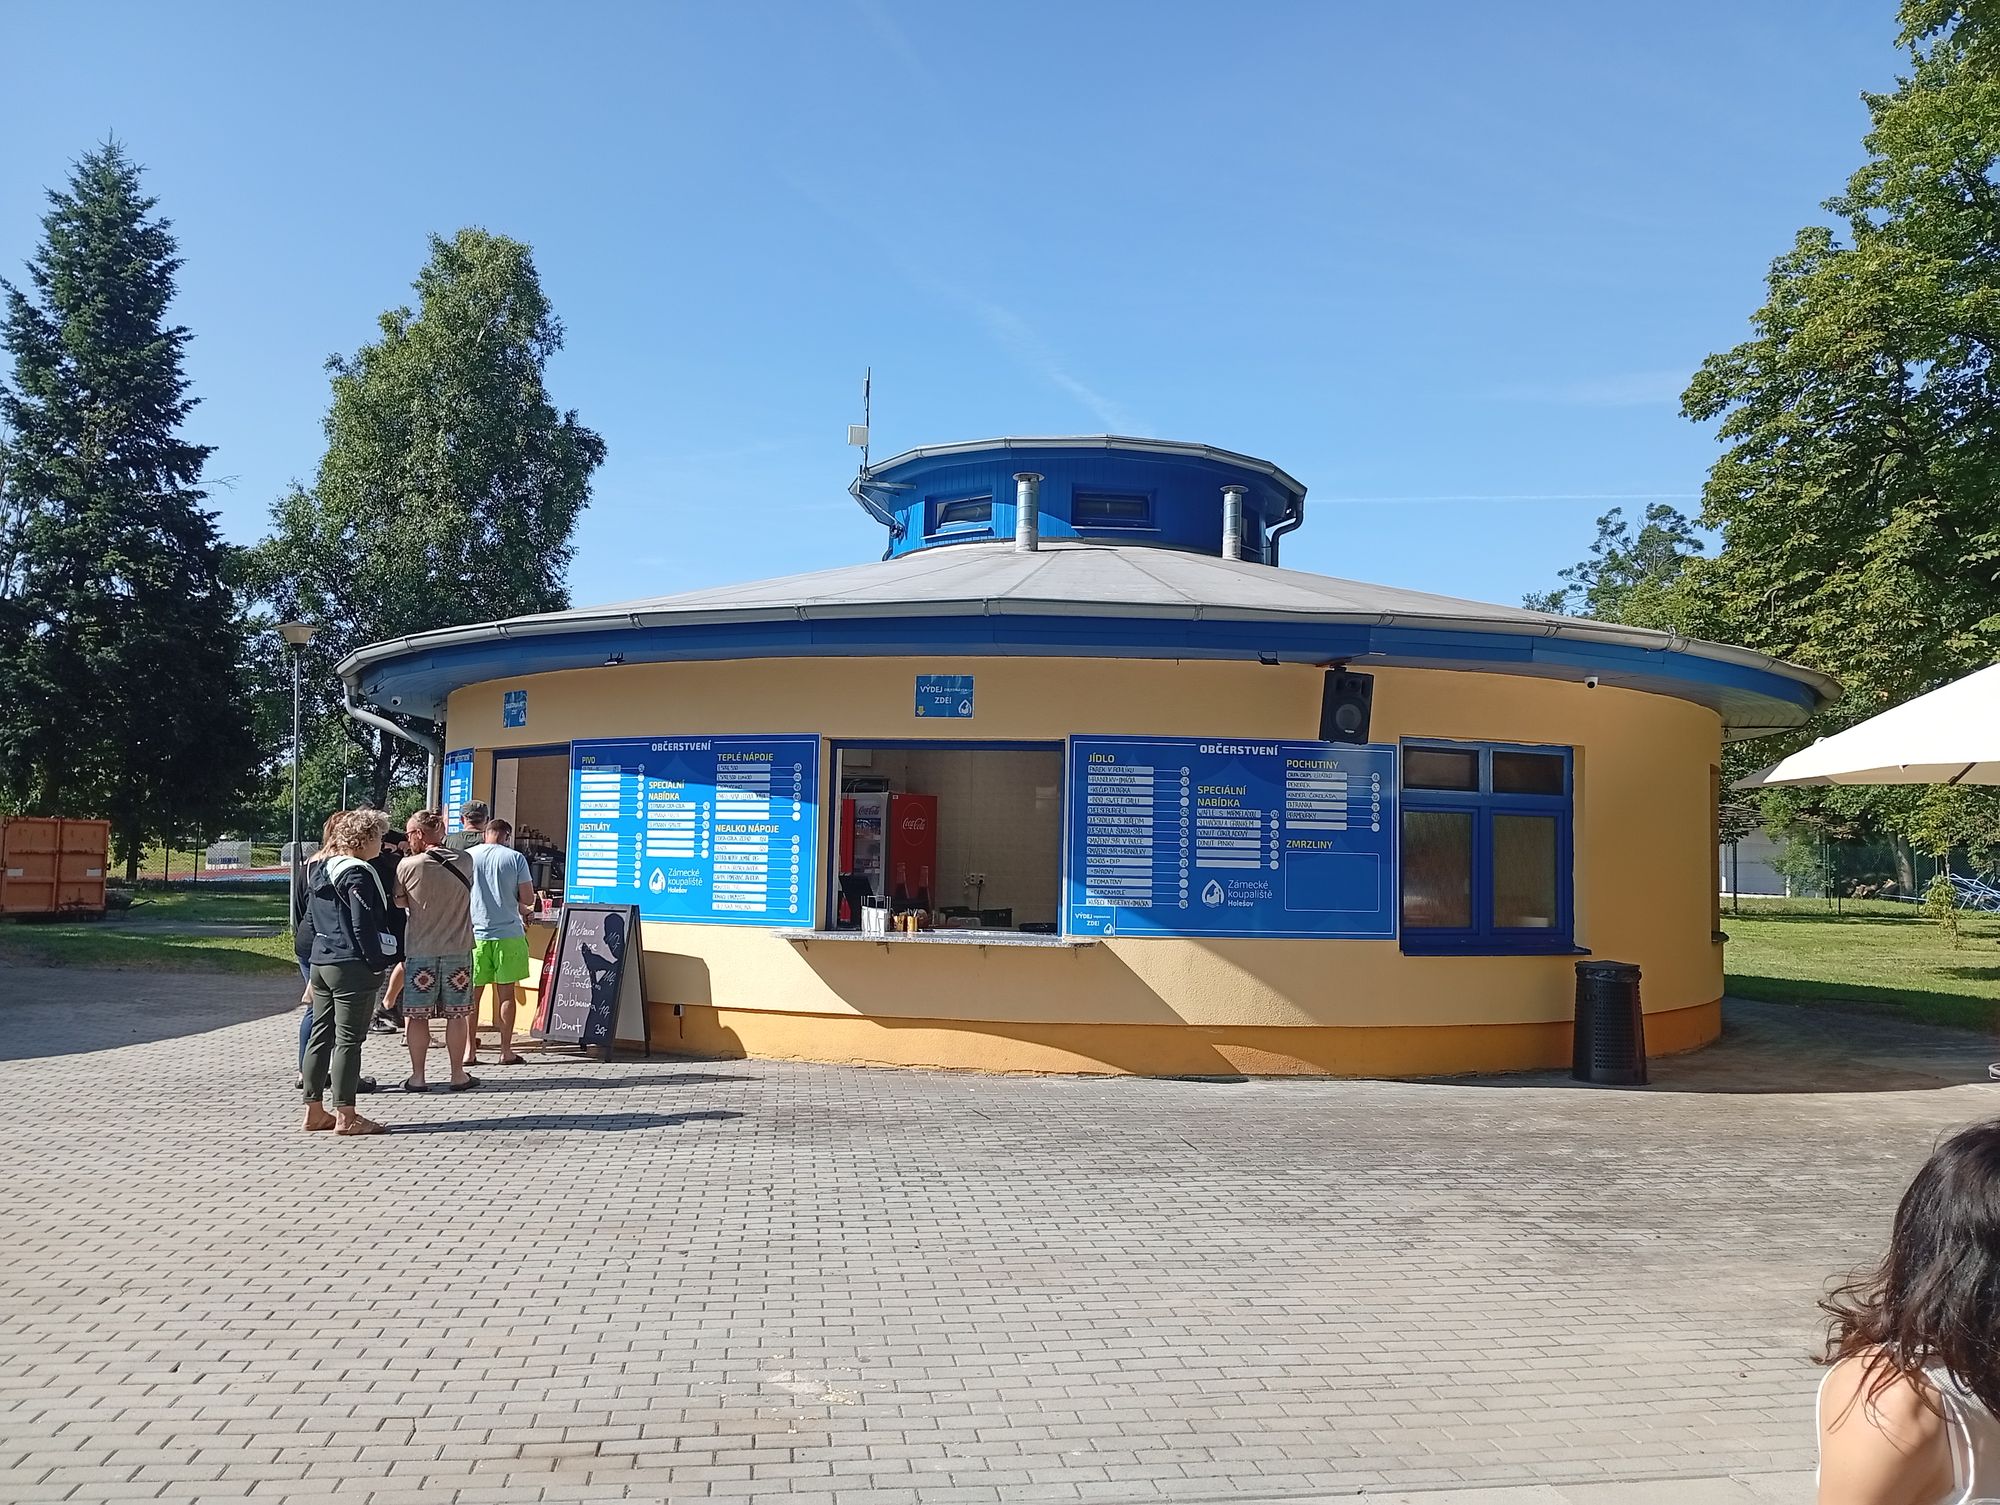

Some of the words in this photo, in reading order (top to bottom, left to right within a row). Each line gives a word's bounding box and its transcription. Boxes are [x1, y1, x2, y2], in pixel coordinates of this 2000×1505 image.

[920, 684, 943, 693] VÝDEJ
[934, 696, 952, 704] ZDE!
[651, 740, 712, 752] OBČERSTVENÍ
[1199, 742, 1279, 756] OBČERSTVENÍ
[581, 756, 596, 764] PIVO
[717, 751, 742, 761] TEPLÉ
[742, 751, 774, 761] NÁPOJE
[1088, 752, 1115, 763] JÍDLO
[1286, 759, 1339, 769] POCHUTINY
[649, 779, 685, 789] SPECIÁLNÍ
[1197, 785, 1247, 795] SPECIÁLNÍ
[648, 791, 680, 801] NABÍDKA
[1197, 797, 1241, 807] NABÍDKA
[580, 821, 611, 831] DESTILÁTY
[714, 824, 747, 833] NEALKO
[748, 822, 780, 834] NÁPOJE
[902, 817, 926, 831] Coca-Cola
[1286, 840, 1333, 849] ZMRZLINY
[668, 867, 700, 877] Zámecké
[667, 877, 703, 887] koupaliště
[1228, 879, 1269, 889] Zámecké
[1228, 889, 1273, 899] koupaliště
[1228, 899, 1254, 907] Holešov
[1074, 911, 1093, 919] VÝDEJ
